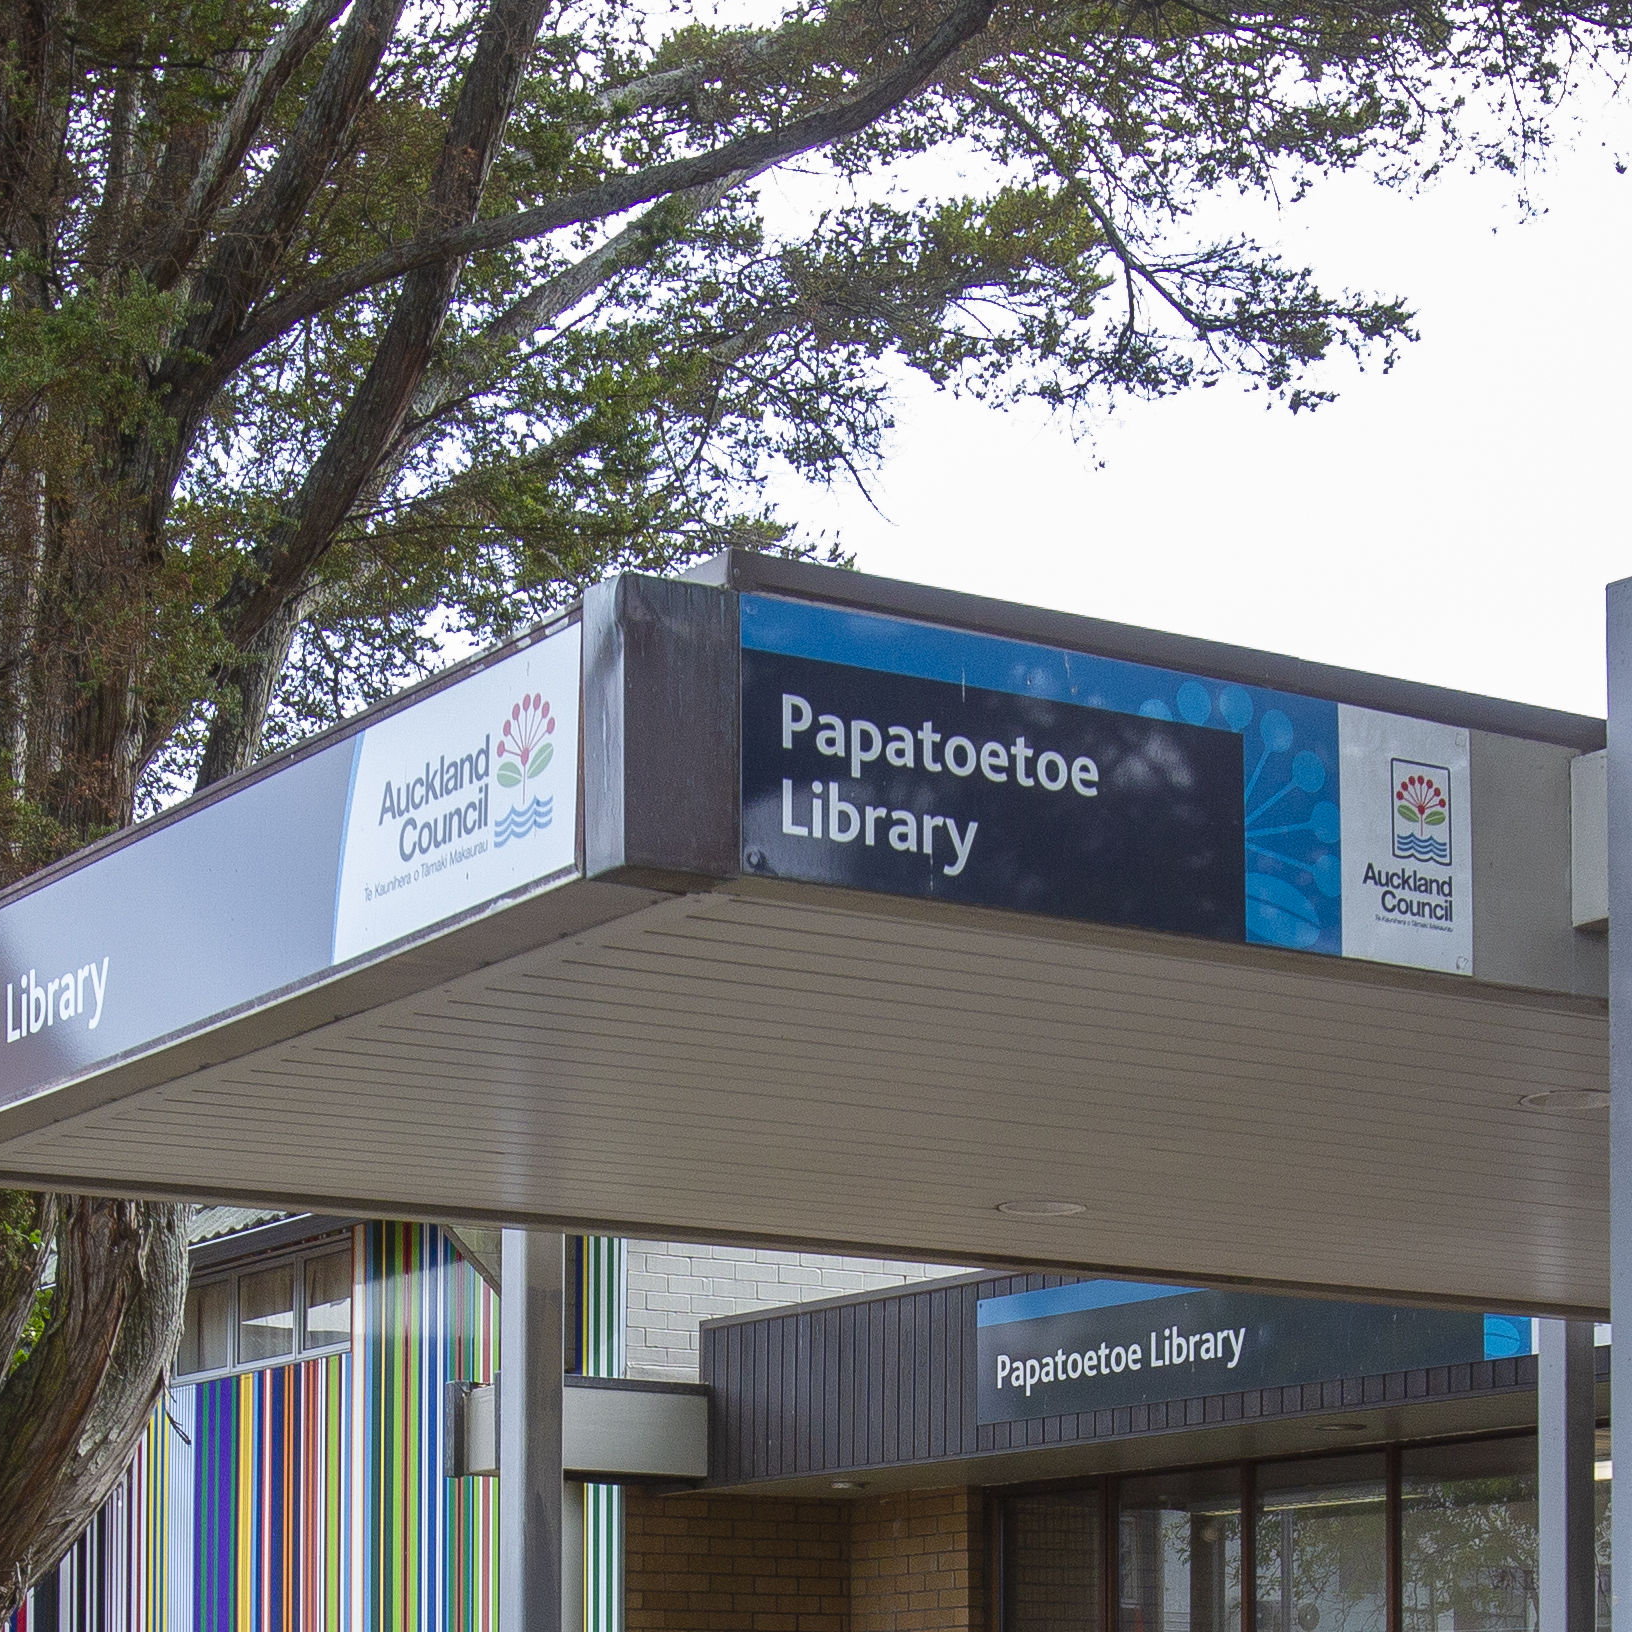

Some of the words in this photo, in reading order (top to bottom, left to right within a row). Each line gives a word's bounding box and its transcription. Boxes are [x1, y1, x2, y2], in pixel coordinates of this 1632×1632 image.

[378, 733, 490, 826] Auckland
[780, 694, 1099, 797] Papatoetoe
[398, 786, 489, 863] Council
[780, 778, 979, 876] Library
[364, 884, 372, 902] Te
[374, 872, 412, 899] Kaunihera
[413, 869, 420, 882] o
[421, 853, 448, 879] Tāmaki
[449, 839, 488, 867] Makaurau
[1362, 862, 1452, 898] Auckland
[1381, 889, 1453, 923] Council
[6, 956, 110, 1042] Library
[996, 1341, 1142, 1397] Papatoetoe
[1150, 1325, 1246, 1369] Library
